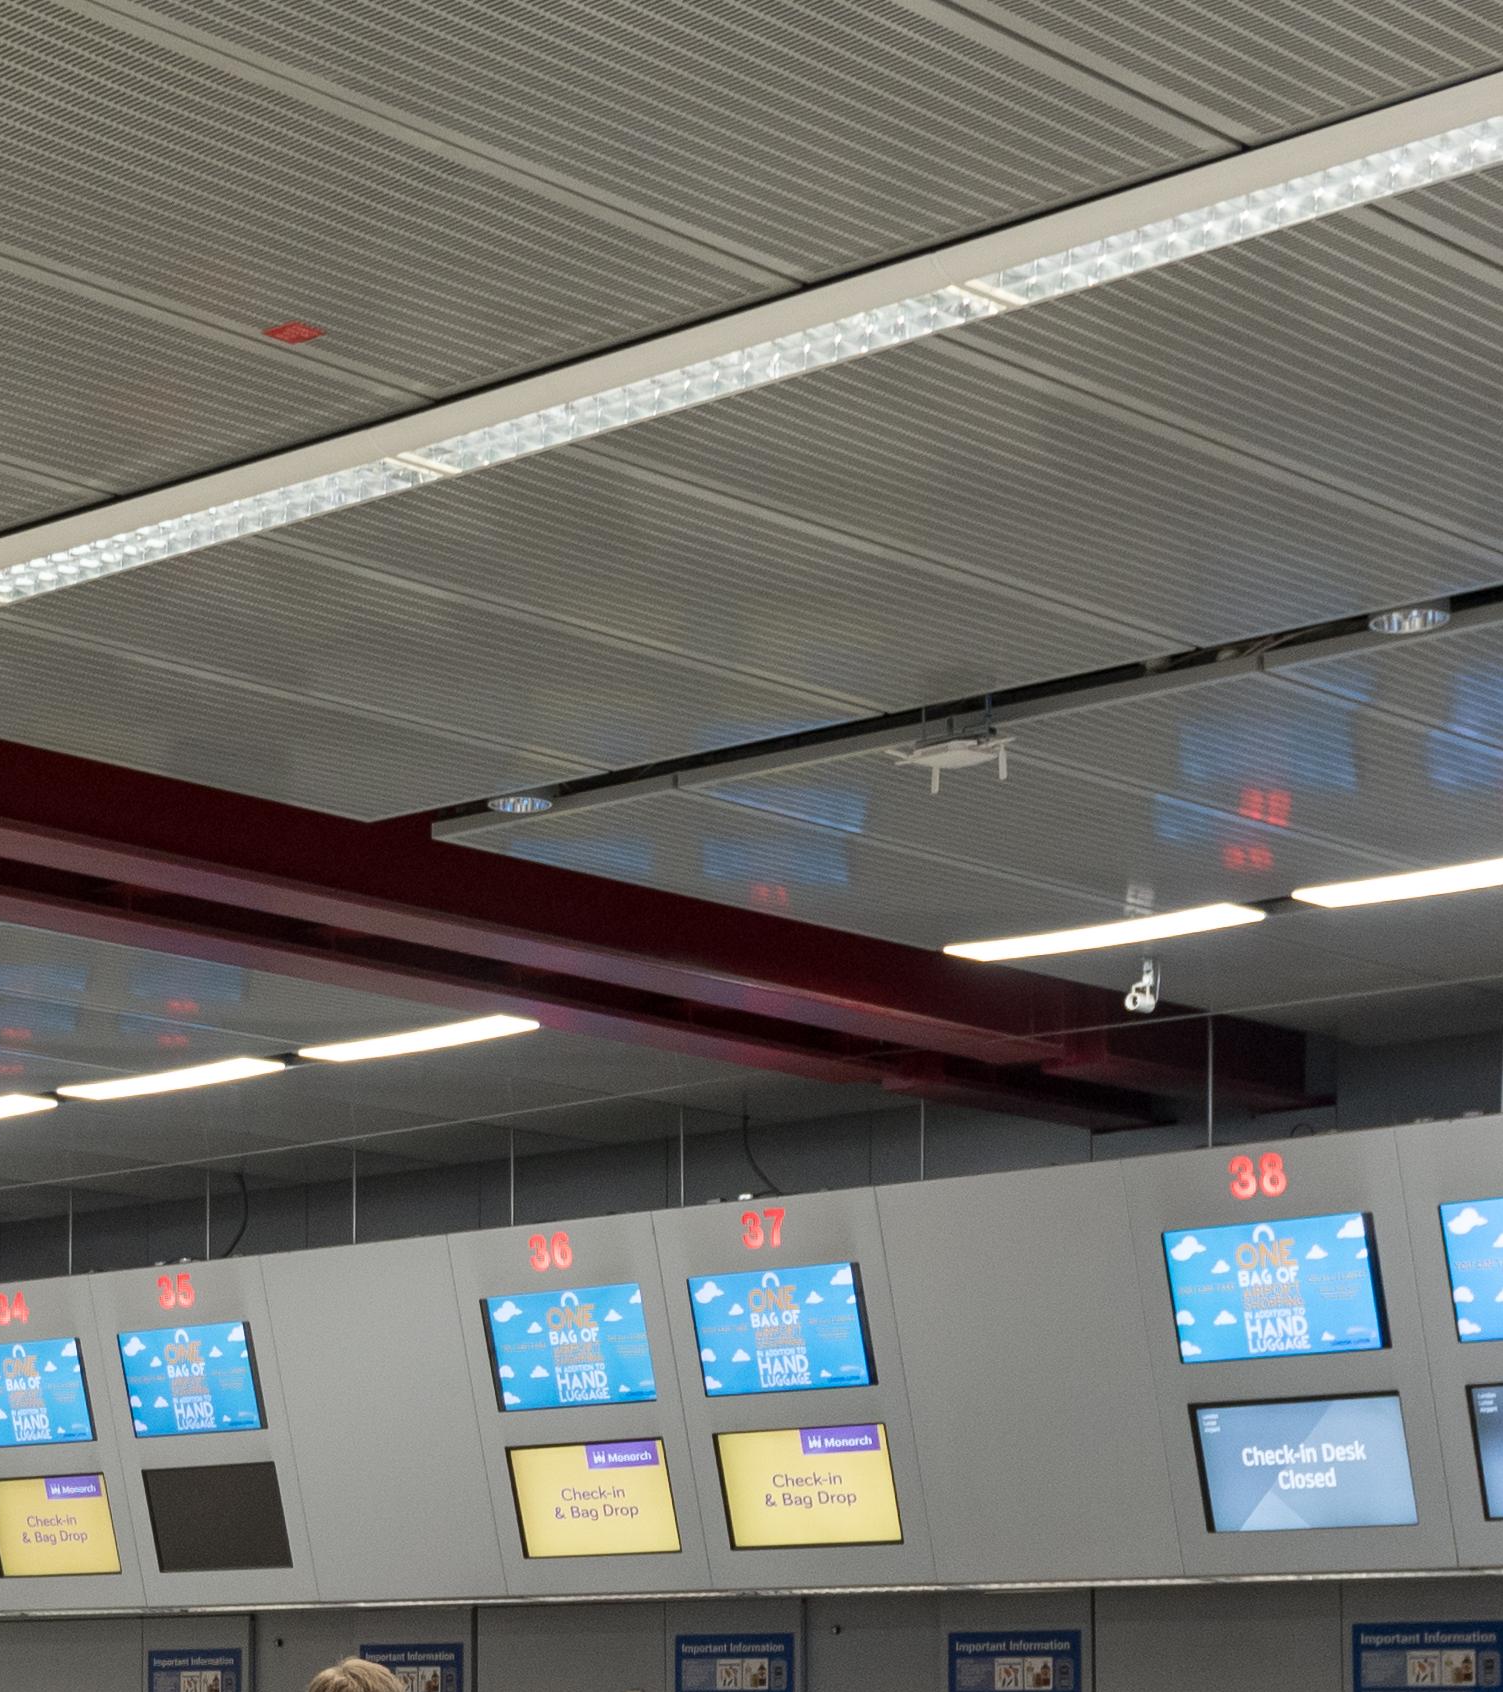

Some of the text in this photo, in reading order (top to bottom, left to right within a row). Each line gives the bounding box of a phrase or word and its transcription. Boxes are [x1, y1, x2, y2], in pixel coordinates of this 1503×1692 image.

[1228, 1152, 1287, 1200] 38
[741, 1207, 785, 1249] 37
[528, 1231, 572, 1272] 36
[1235, 1237, 1298, 1269] ONE
[1237, 1269, 1273, 1288] BAG
[1275, 1265, 1300, 1282] OF
[157, 1272, 195, 1310] 35
[748, 1285, 799, 1313] ONE
[546, 1303, 598, 1330] ONE
[750, 1309, 801, 1328] BAG OF
[1293, 1306, 1306, 1316] TO
[548, 1326, 599, 1346] BAG OF
[1245, 1316, 1308, 1340] HAND
[1248, 1335, 1312, 1353] LUGGAGE
[167, 1362, 206, 1378] BAG OF
[757, 1354, 809, 1375] HAND
[5, 1375, 42, 1391] BAG OF
[556, 1370, 608, 1393] HAND
[760, 1372, 812, 1389] LUGGAGE
[559, 1387, 611, 1403] LUGGAGE
[173, 1401, 214, 1418] HAND
[12, 1414, 49, 1431] HAND
[824, 1435, 872, 1448] Monarch
[607, 1450, 652, 1463] Monarch
[1242, 1440, 1367, 1467] Check-in Desk
[772, 1472, 842, 1488] Check-in
[1278, 1467, 1337, 1490] Closed
[62, 1484, 96, 1494] Monarch
[561, 1486, 625, 1502] Check-in
[765, 1490, 857, 1509] & Bag Drop
[27, 1514, 77, 1528] Check-in
[555, 1503, 639, 1521] & Bag Drop
[22, 1530, 88, 1545] & Bag Drop
[955, 1639, 1070, 1653] Important Information
[1360, 1631, 1497, 1646] Important Information
[682, 1642, 784, 1656] Important Information
